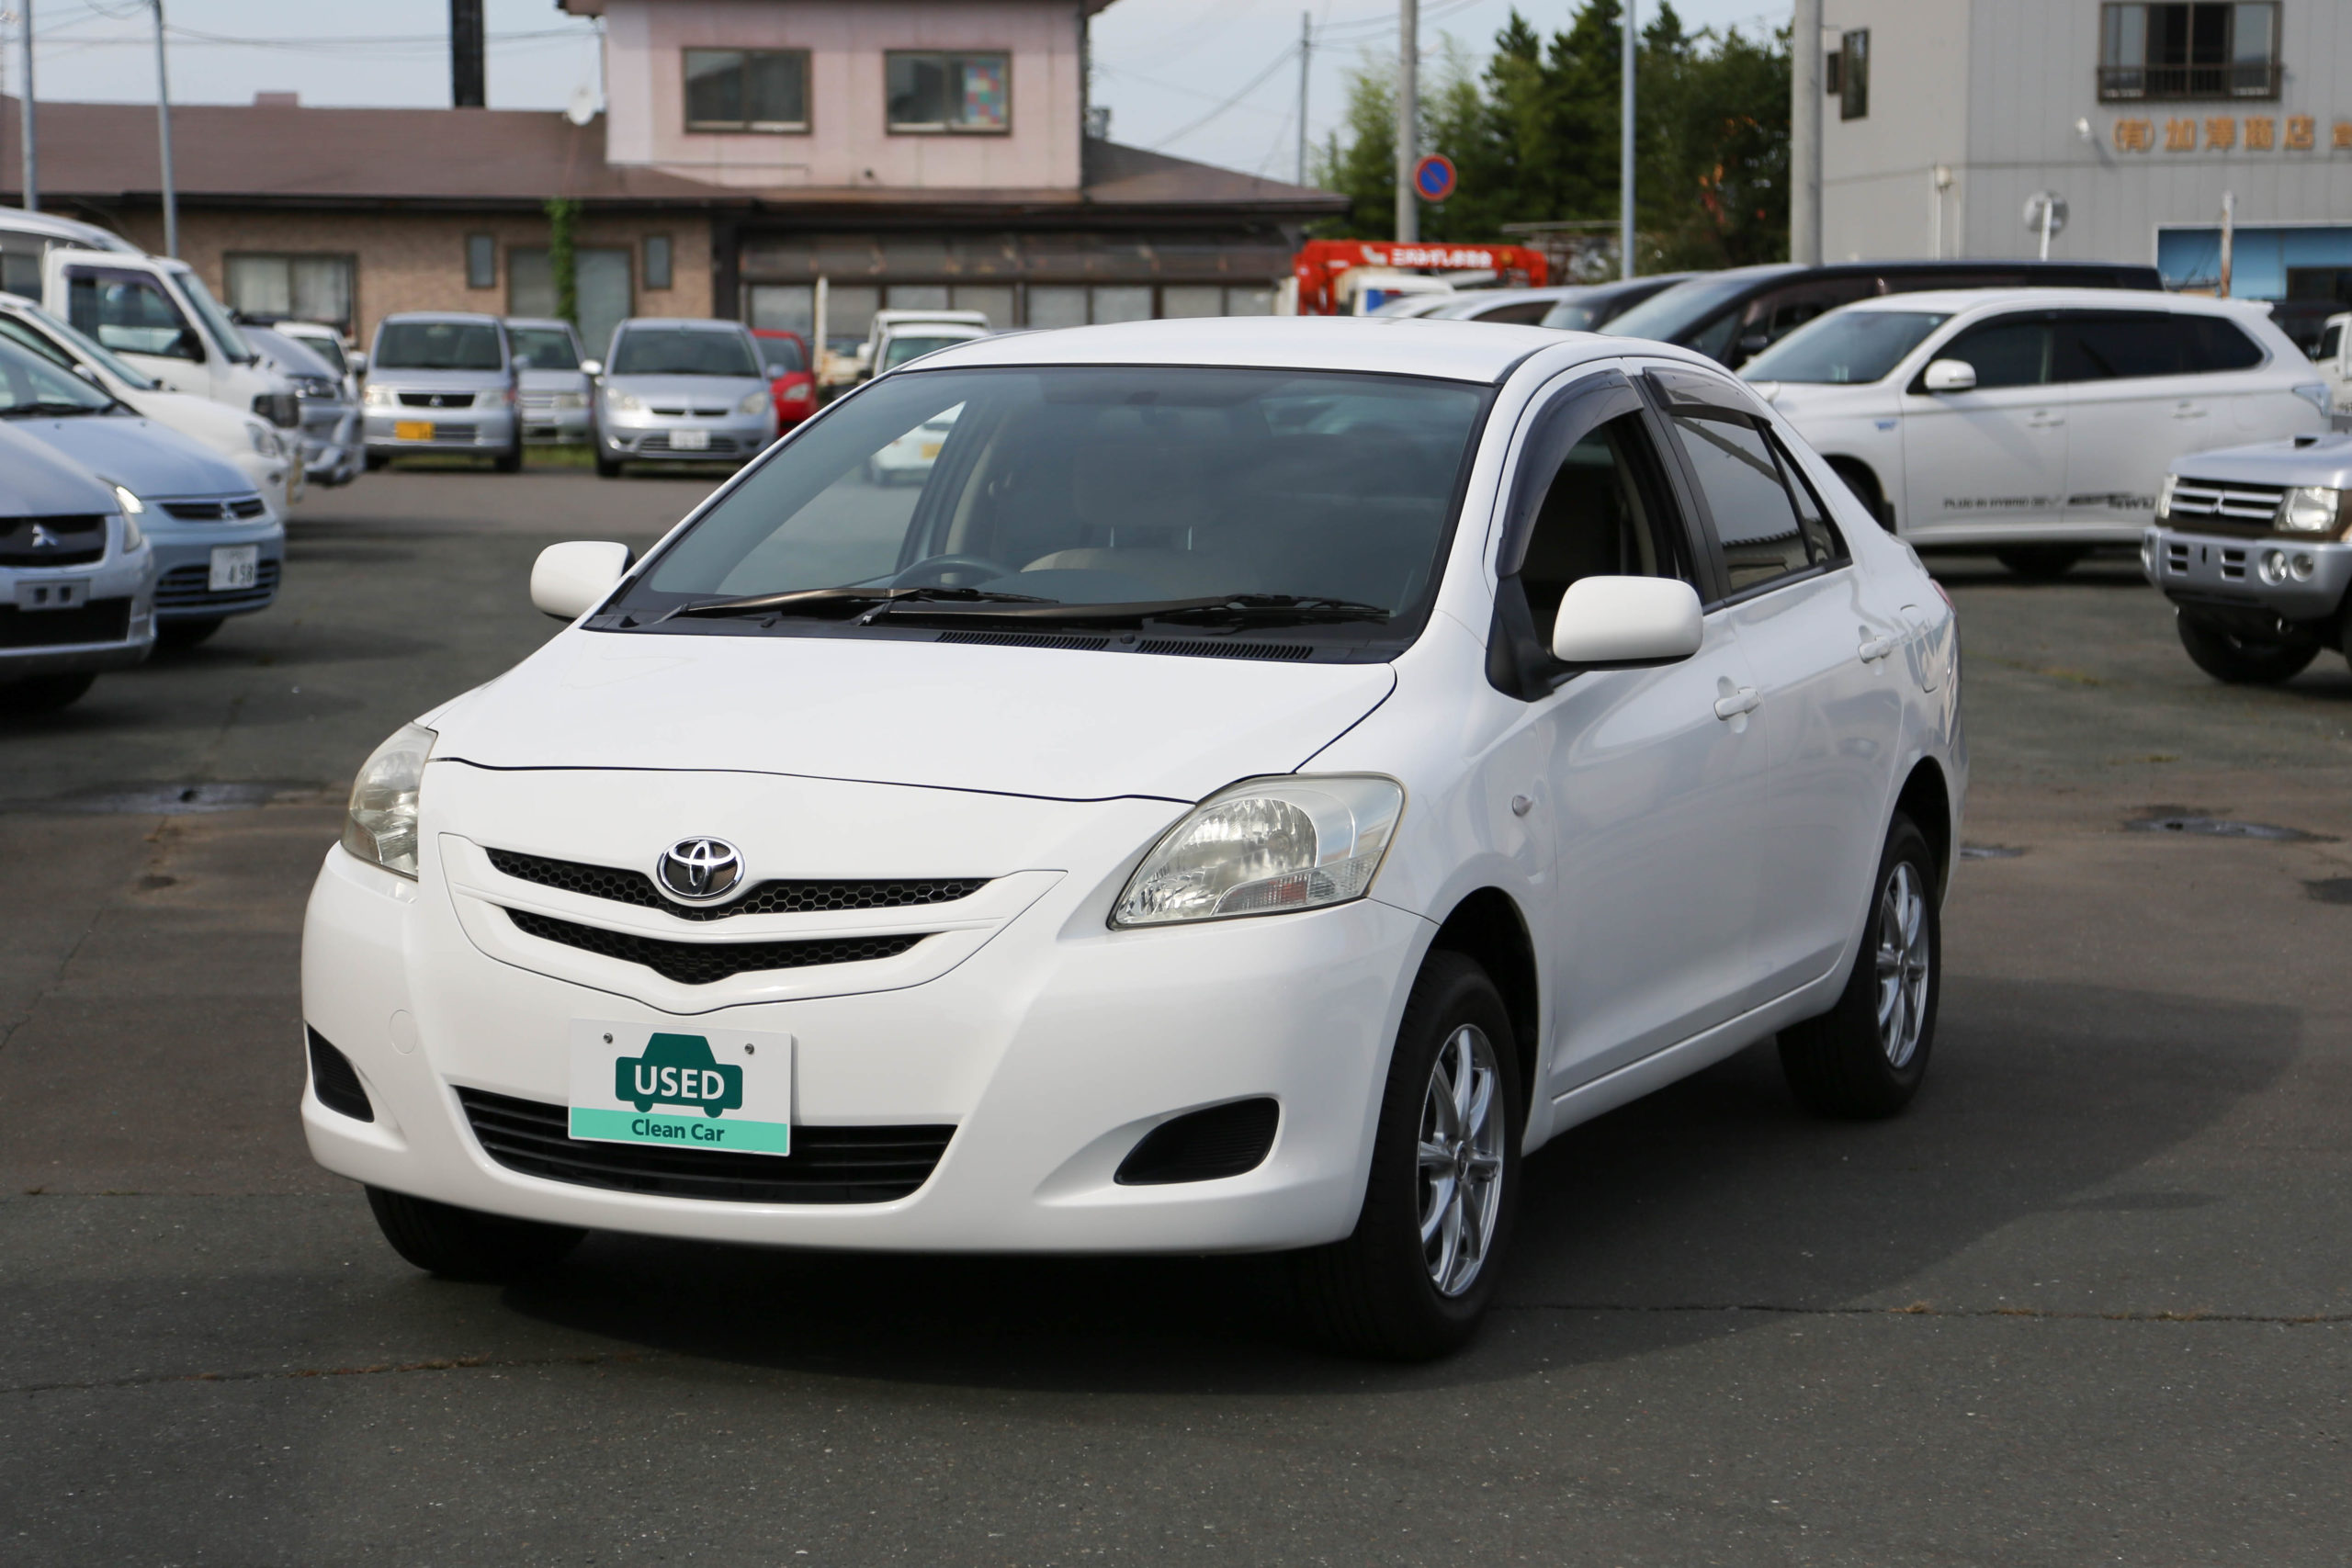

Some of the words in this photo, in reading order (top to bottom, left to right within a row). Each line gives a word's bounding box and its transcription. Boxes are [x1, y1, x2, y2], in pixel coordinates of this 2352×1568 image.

[635, 1065, 725, 1100] USED
[631, 1119, 685, 1139] Clean
[691, 1123, 725, 1142] Car
